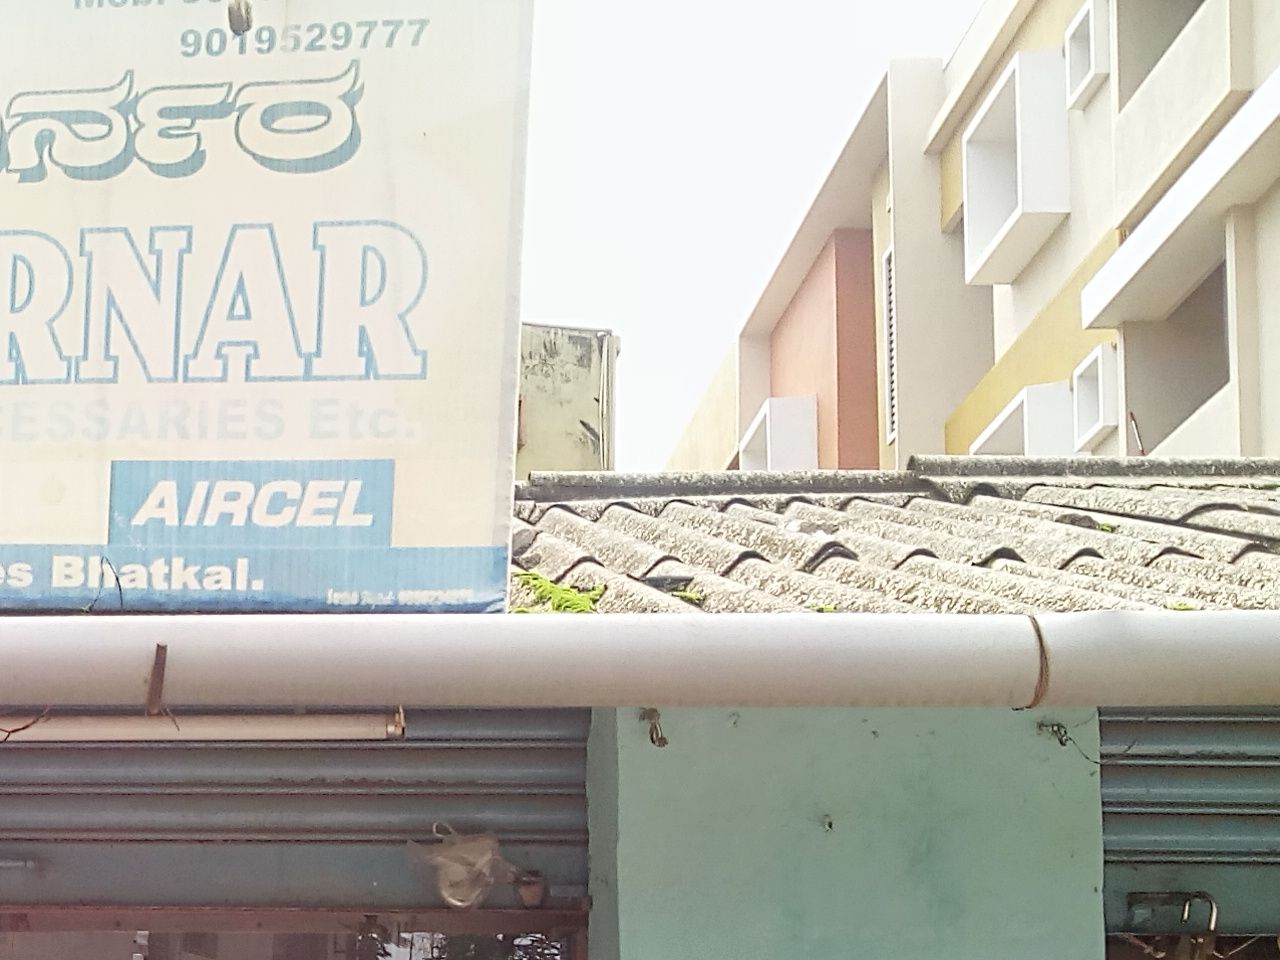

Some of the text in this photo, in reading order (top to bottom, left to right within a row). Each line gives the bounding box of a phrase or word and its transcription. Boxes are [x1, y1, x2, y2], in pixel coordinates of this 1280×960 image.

[180, 19, 430, 57] 9019529777
[131, 479, 373, 527] AIRCEL
[51, 556, 264, 591] Bhatkal.
